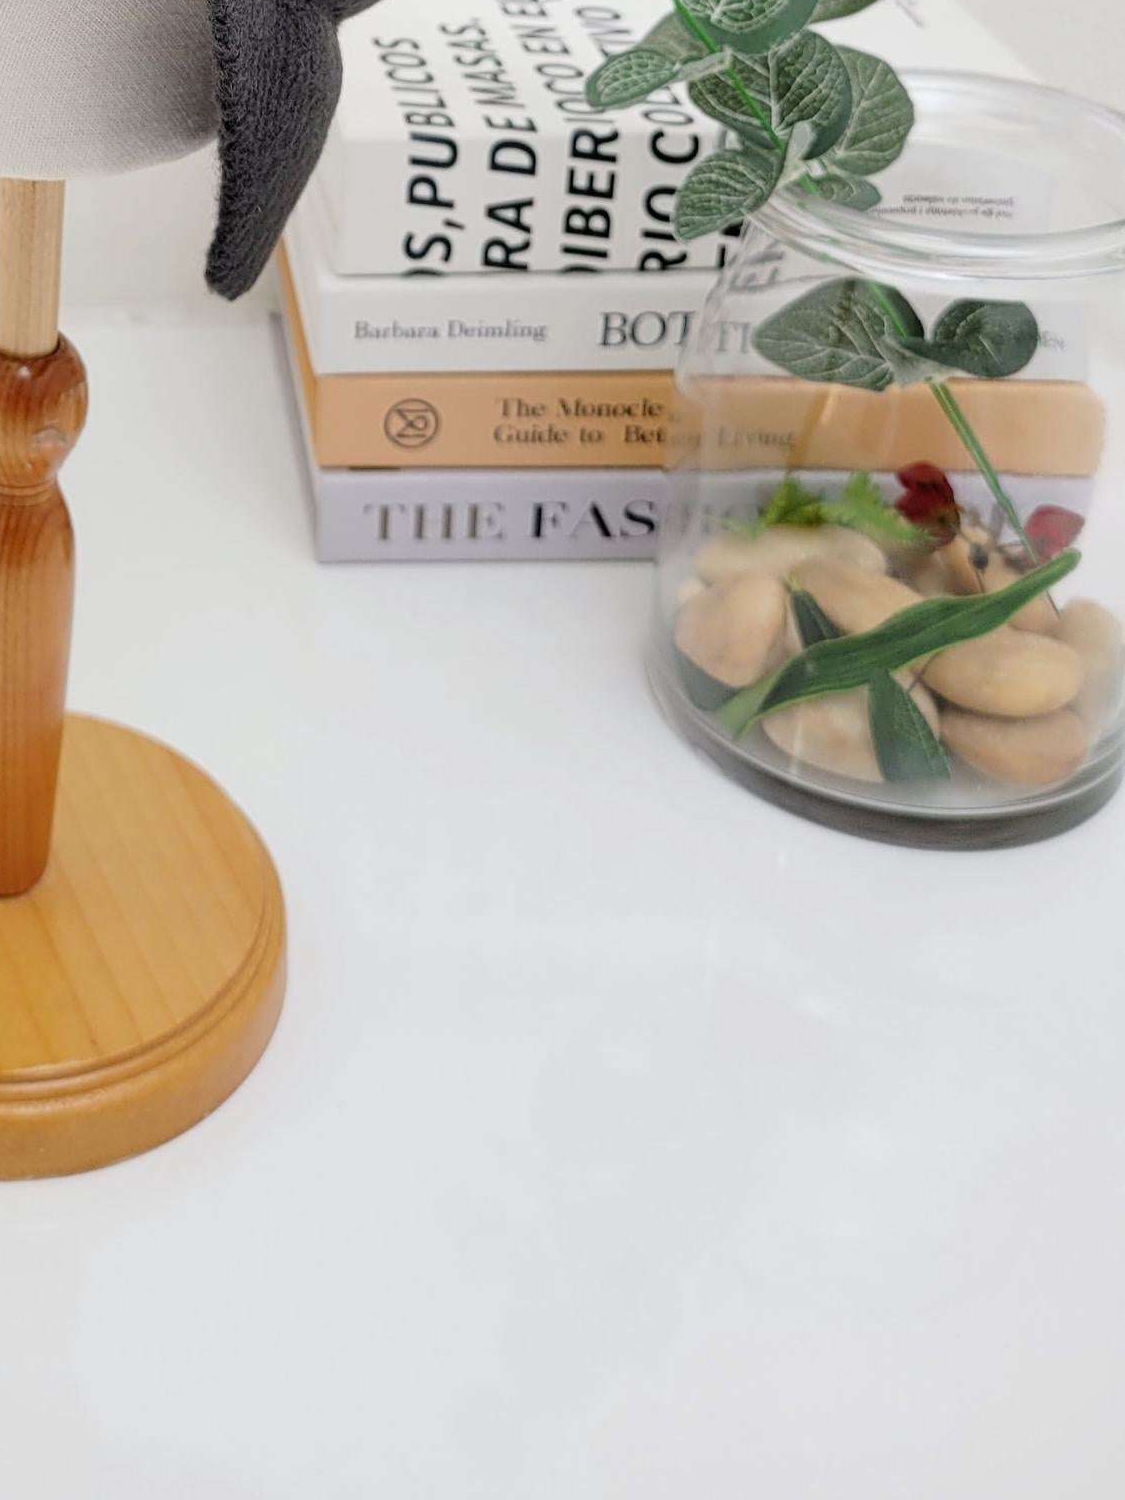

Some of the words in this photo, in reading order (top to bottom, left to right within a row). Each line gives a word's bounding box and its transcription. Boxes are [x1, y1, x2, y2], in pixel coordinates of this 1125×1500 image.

[516, 24, 570, 55] EN
[482, 115, 538, 176] DE
[354, 320, 439, 340] Barbara
[447, 318, 548, 342] Deimling
[497, 398, 546, 418] The
[557, 397, 663, 418] Monocle
[493, 424, 569, 444] Guide
[579, 426, 604, 444] to
[362, 503, 503, 541] THE
